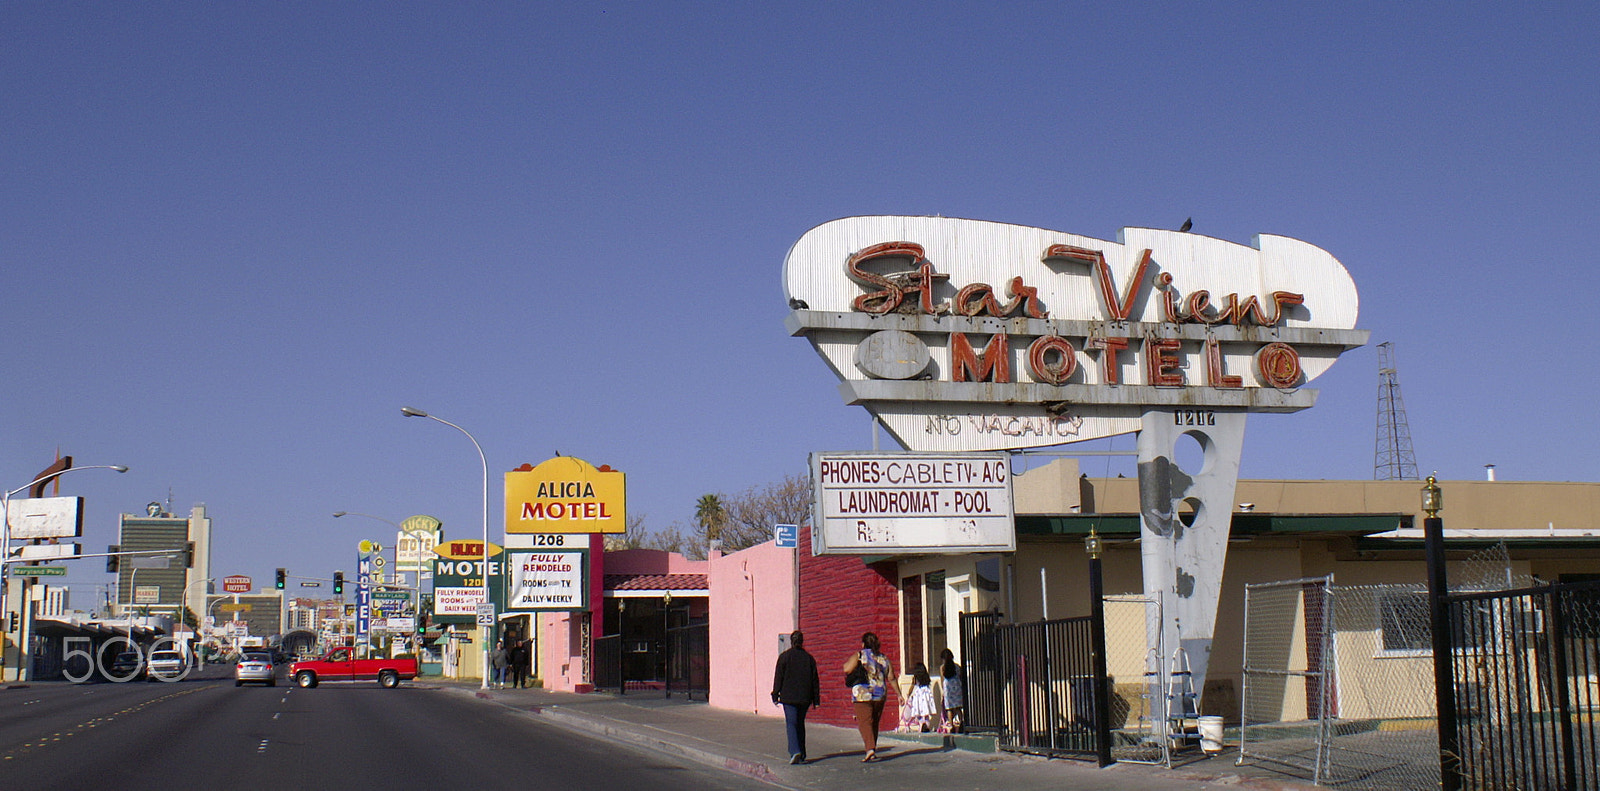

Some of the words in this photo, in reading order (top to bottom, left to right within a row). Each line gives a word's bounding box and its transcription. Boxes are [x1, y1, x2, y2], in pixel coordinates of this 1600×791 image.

[844, 241, 1050, 319] Star
[1041, 244, 1304, 328] View
[926, 414, 961, 436] NO
[968, 413, 1083, 437] VACANCY
[982, 461, 1006, 483] A/C
[537, 481, 596, 498] ALICIA
[839, 490, 939, 513] LAUNDROMAT
[954, 490, 991, 513] POOL
[520, 502, 612, 521] MOTEL
[402, 516, 437, 533] LUCKY
[533, 535, 564, 546] 1208
[530, 554, 564, 562] FULLY
[523, 564, 572, 572] REMODELED
[522, 580, 547, 588] ROOMS
[360, 561, 370, 634] MOTEL
[478, 614, 493, 624] 25
